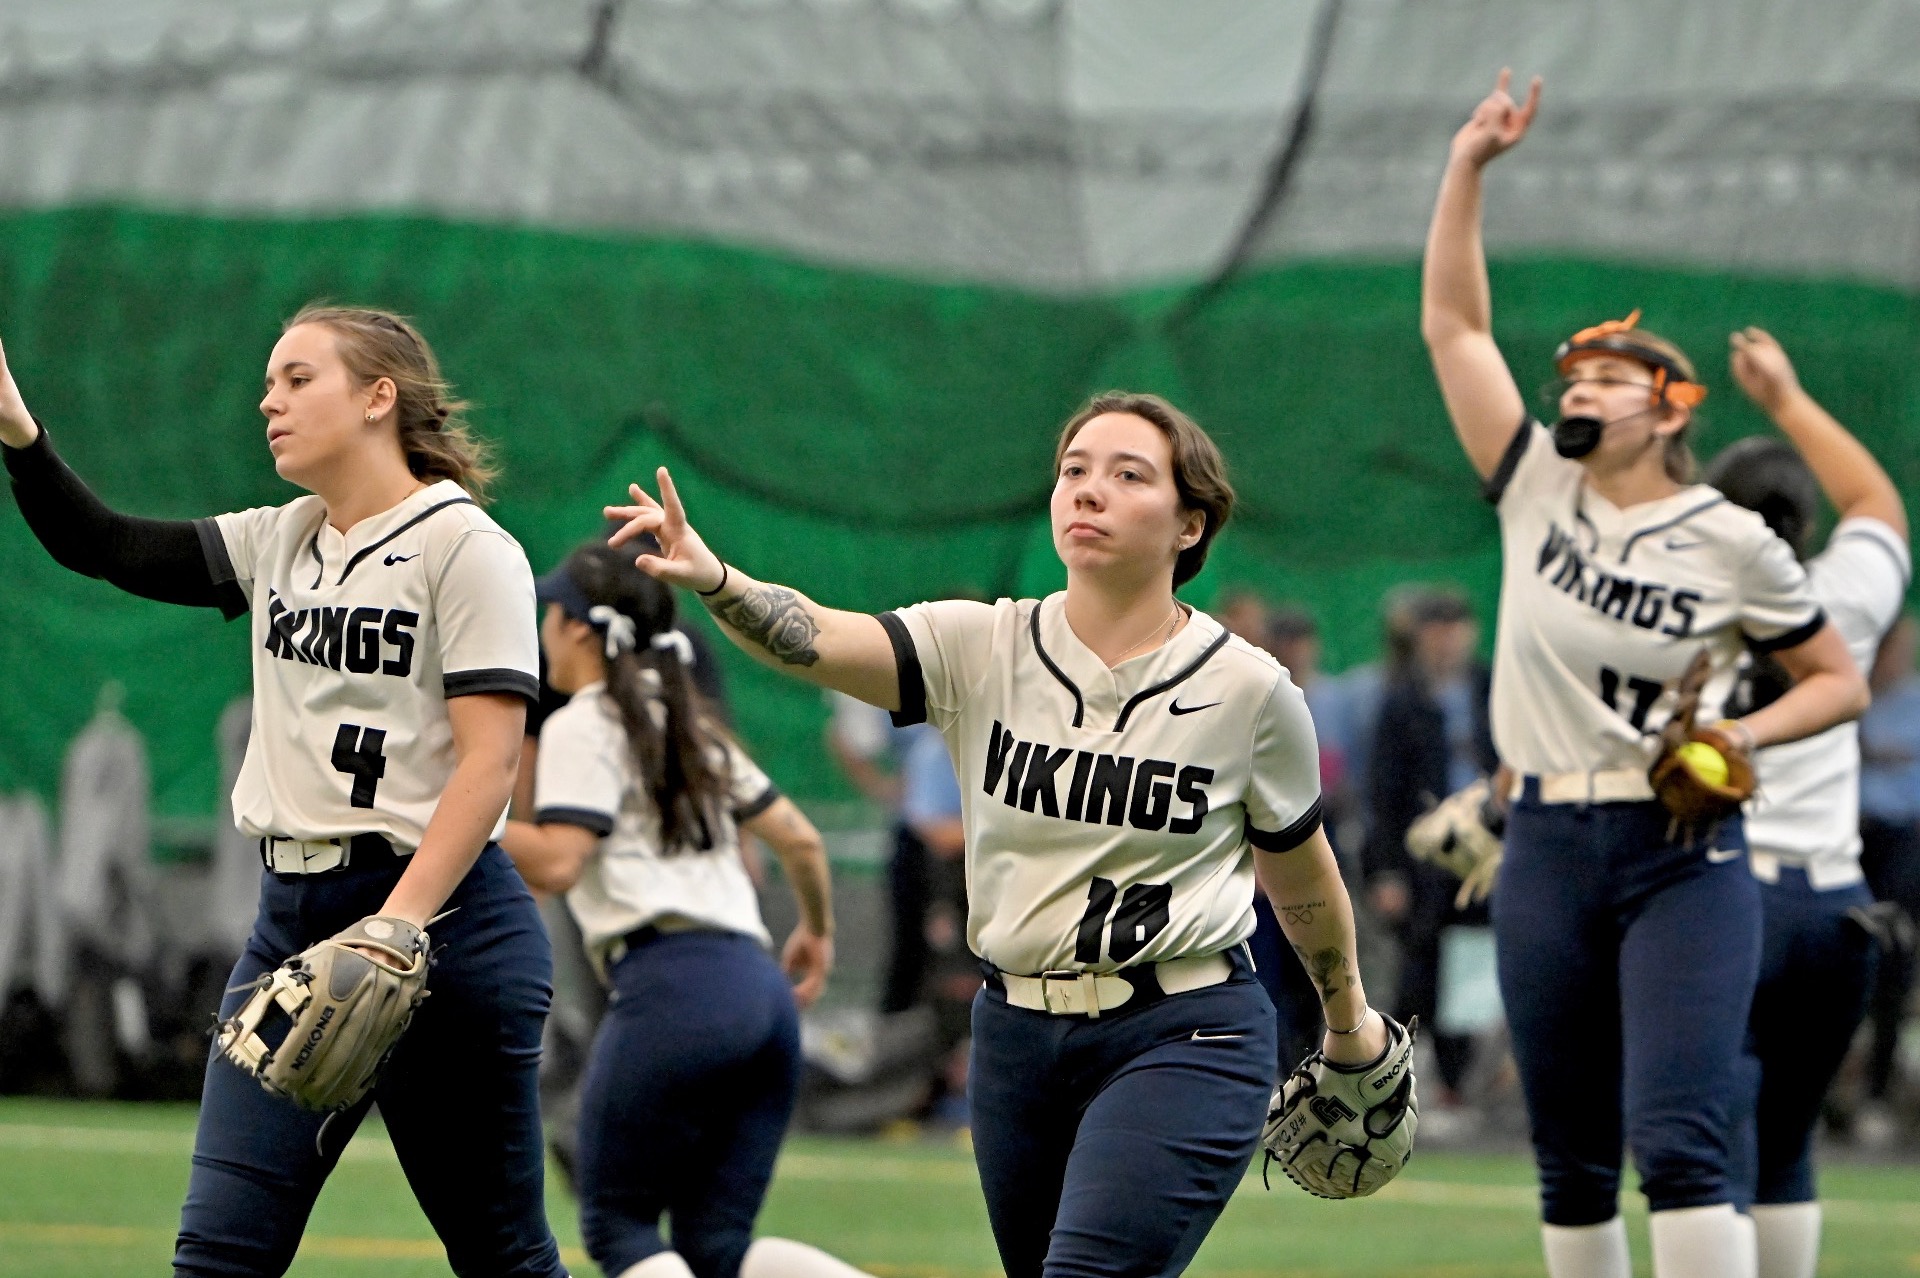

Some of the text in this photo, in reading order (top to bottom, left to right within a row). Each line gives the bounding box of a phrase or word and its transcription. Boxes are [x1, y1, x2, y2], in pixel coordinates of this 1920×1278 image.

[1536, 522, 1704, 639] VIKINGS
[331, 723, 387, 809] 4
[983, 719, 1215, 834] VIKINGS
